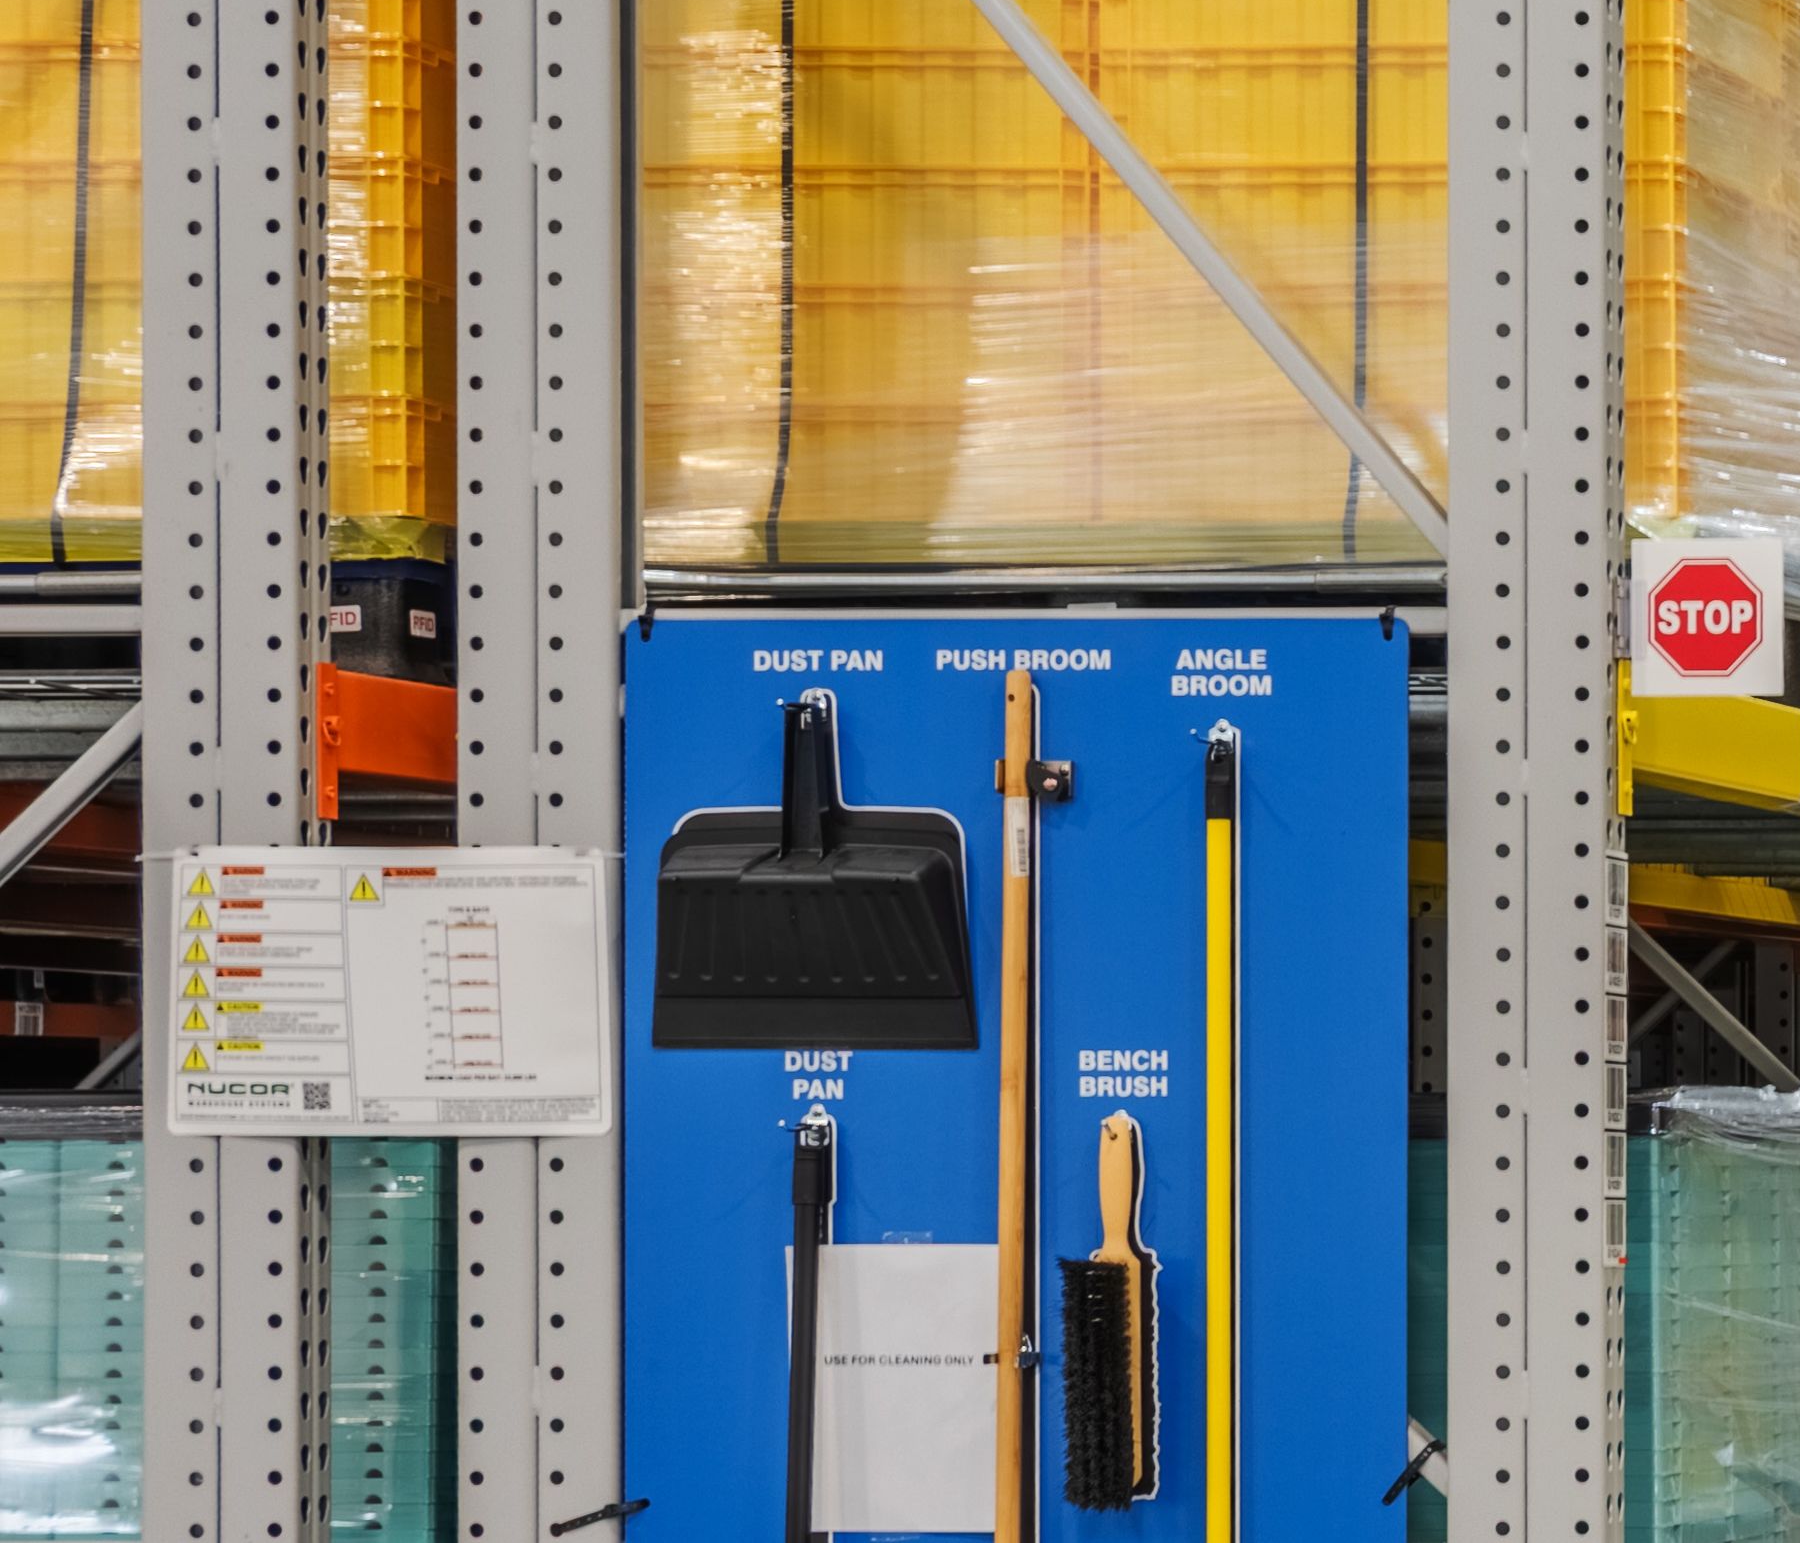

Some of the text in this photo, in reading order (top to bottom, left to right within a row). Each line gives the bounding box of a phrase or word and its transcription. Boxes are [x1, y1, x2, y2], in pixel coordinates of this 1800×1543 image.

[331, 612, 357, 626] FID
[413, 615, 434, 632] RFID
[1658, 600, 1753, 635] STOP
[754, 650, 883, 671] DUST PAN
[937, 649, 1111, 671] PUSH BROOM
[1177, 649, 1267, 671] ANGLE
[1172, 674, 1272, 696] BROOM
[785, 1051, 852, 1071] DUST
[1079, 1050, 1168, 1071] BENCH
[188, 1083, 290, 1095] NUCOR
[793, 1078, 844, 1099] PAN
[1079, 1075, 1168, 1097] BRUSH
[824, 1354, 974, 1367] USE FOR CLEANING ONLY
